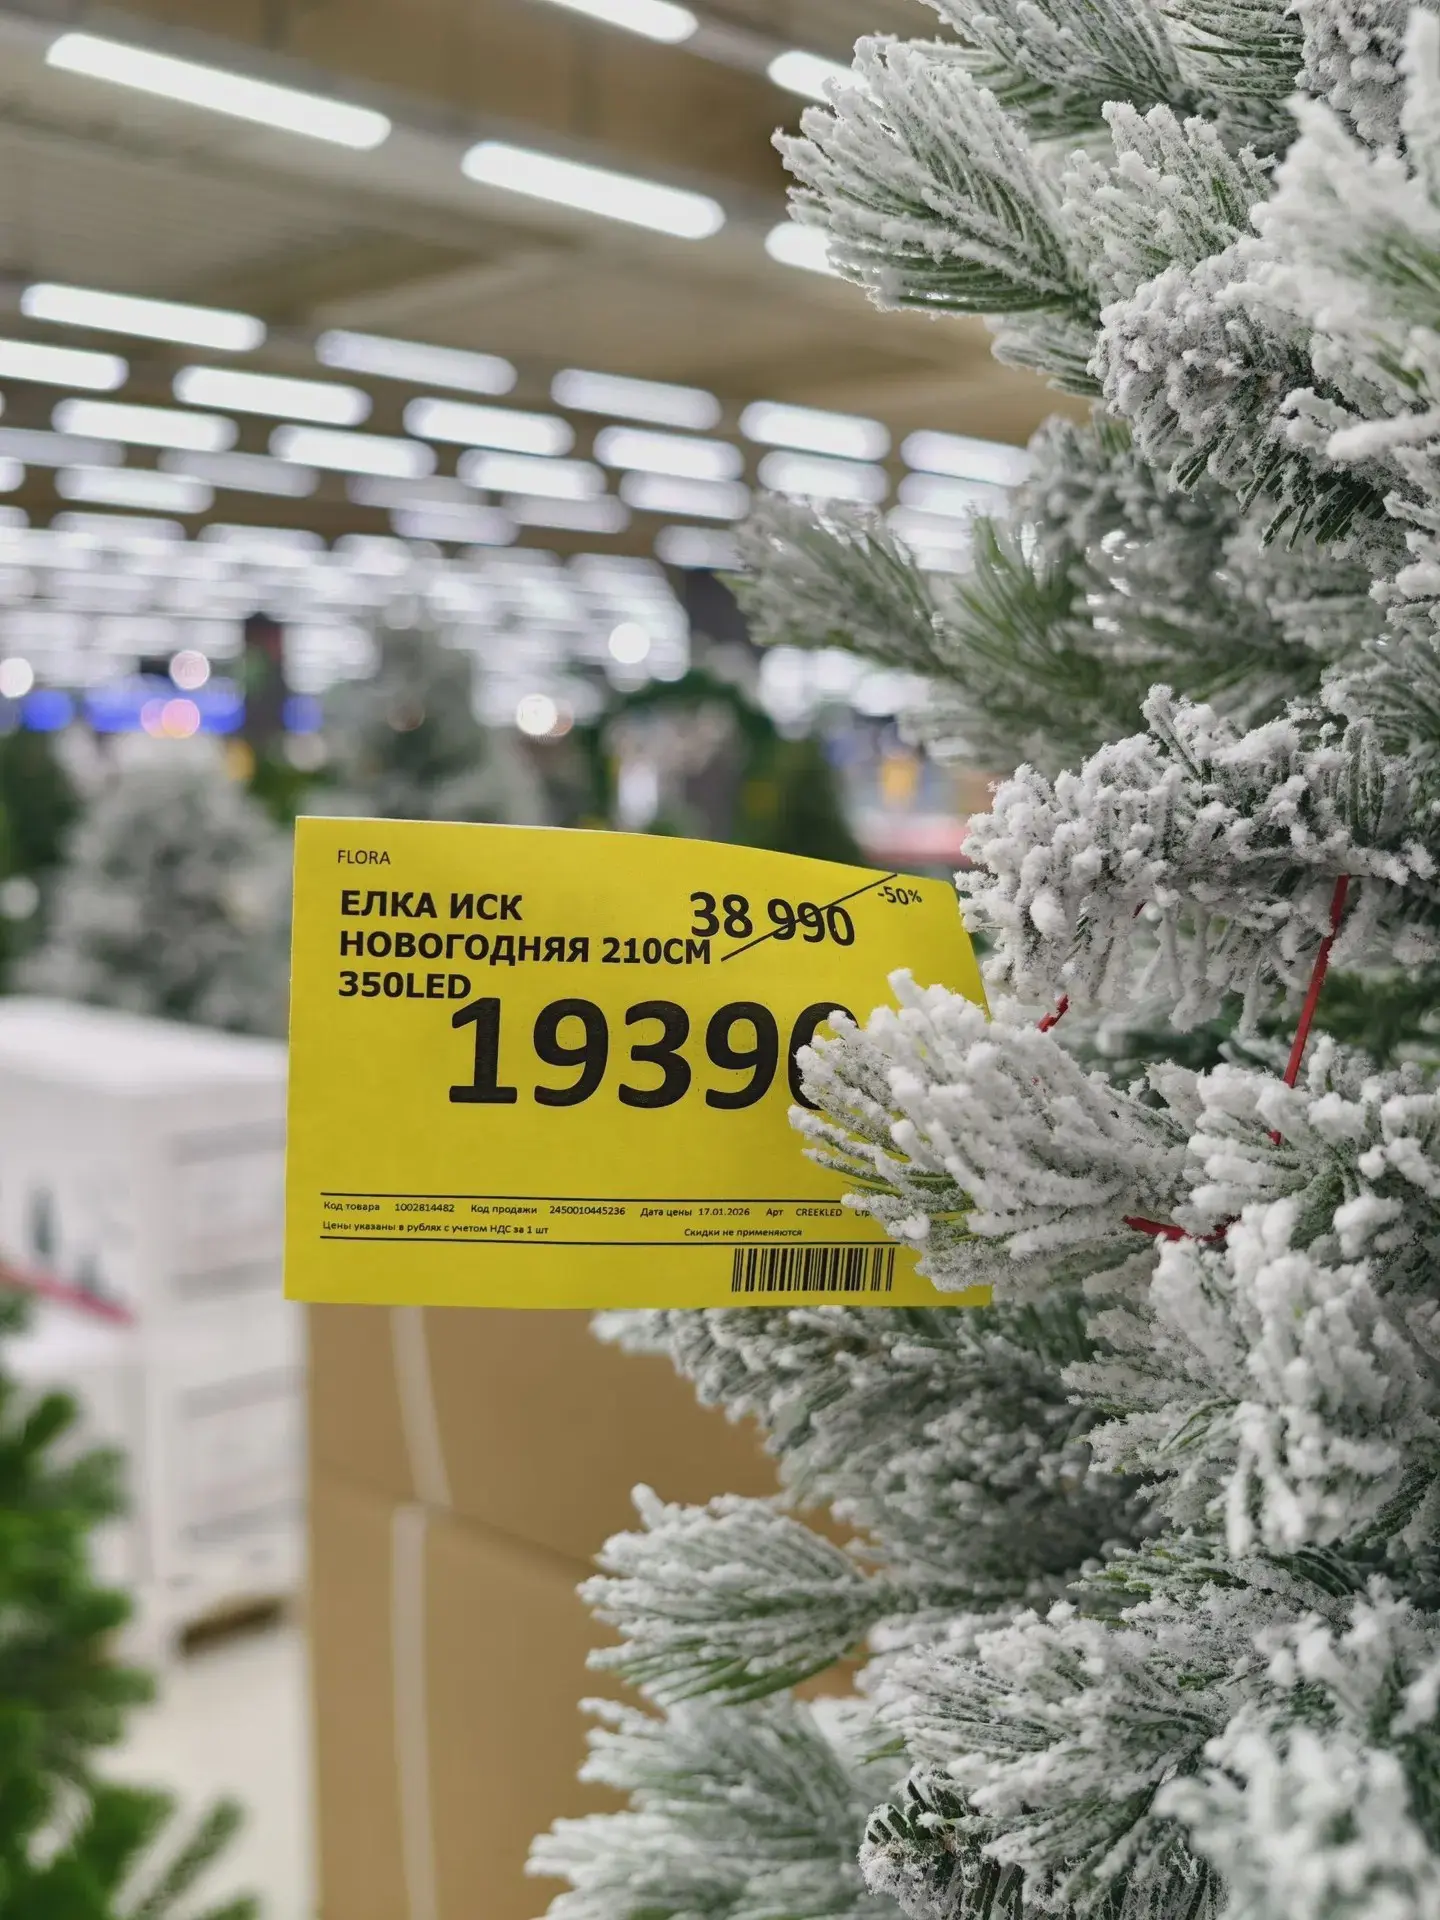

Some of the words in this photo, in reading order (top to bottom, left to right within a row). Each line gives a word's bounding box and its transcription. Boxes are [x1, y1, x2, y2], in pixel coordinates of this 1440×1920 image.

[337, 849, 391, 865] FLORA
[340, 889, 438, 919] ЕЛКА
[449, 892, 523, 921] ИСК
[877, 885, 923, 906] -50%
[690, 890, 754, 939] 38
[767, 897, 856, 947] 990
[339, 930, 590, 967] НОВОГОДНЯЯ
[601, 936, 712, 966] 210СМ
[338, 970, 472, 1000] 350LED
[323, 1200, 344, 1213] Код
[345, 1202, 381, 1213] товара
[394, 1202, 456, 1213] 1002814482
[470, 1204, 490, 1215] Код
[492, 1205, 538, 1216] продажи
[549, 1205, 626, 1216] 2450010445236
[639, 1207, 664, 1218] Дата
[666, 1209, 693, 1218] цены
[698, 1207, 751, 1216] 17.01.2026
[765, 1207, 785, 1218] Арт
[795, 1207, 843, 1217] CREEKLED
[322, 1220, 352, 1231] Цены
[353, 1223, 396, 1233] указаны
[406, 1222, 442, 1234] рублях
[451, 1225, 488, 1235] учетом
[489, 1225, 512, 1235] НДС
[512, 1226, 525, 1234] за
[526, 1225, 533, 1234] 1
[535, 1227, 549, 1235] шт
[684, 1227, 721, 1238] Скидки
[722, 1229, 735, 1237] не
[736, 1229, 803, 1239] применяются
